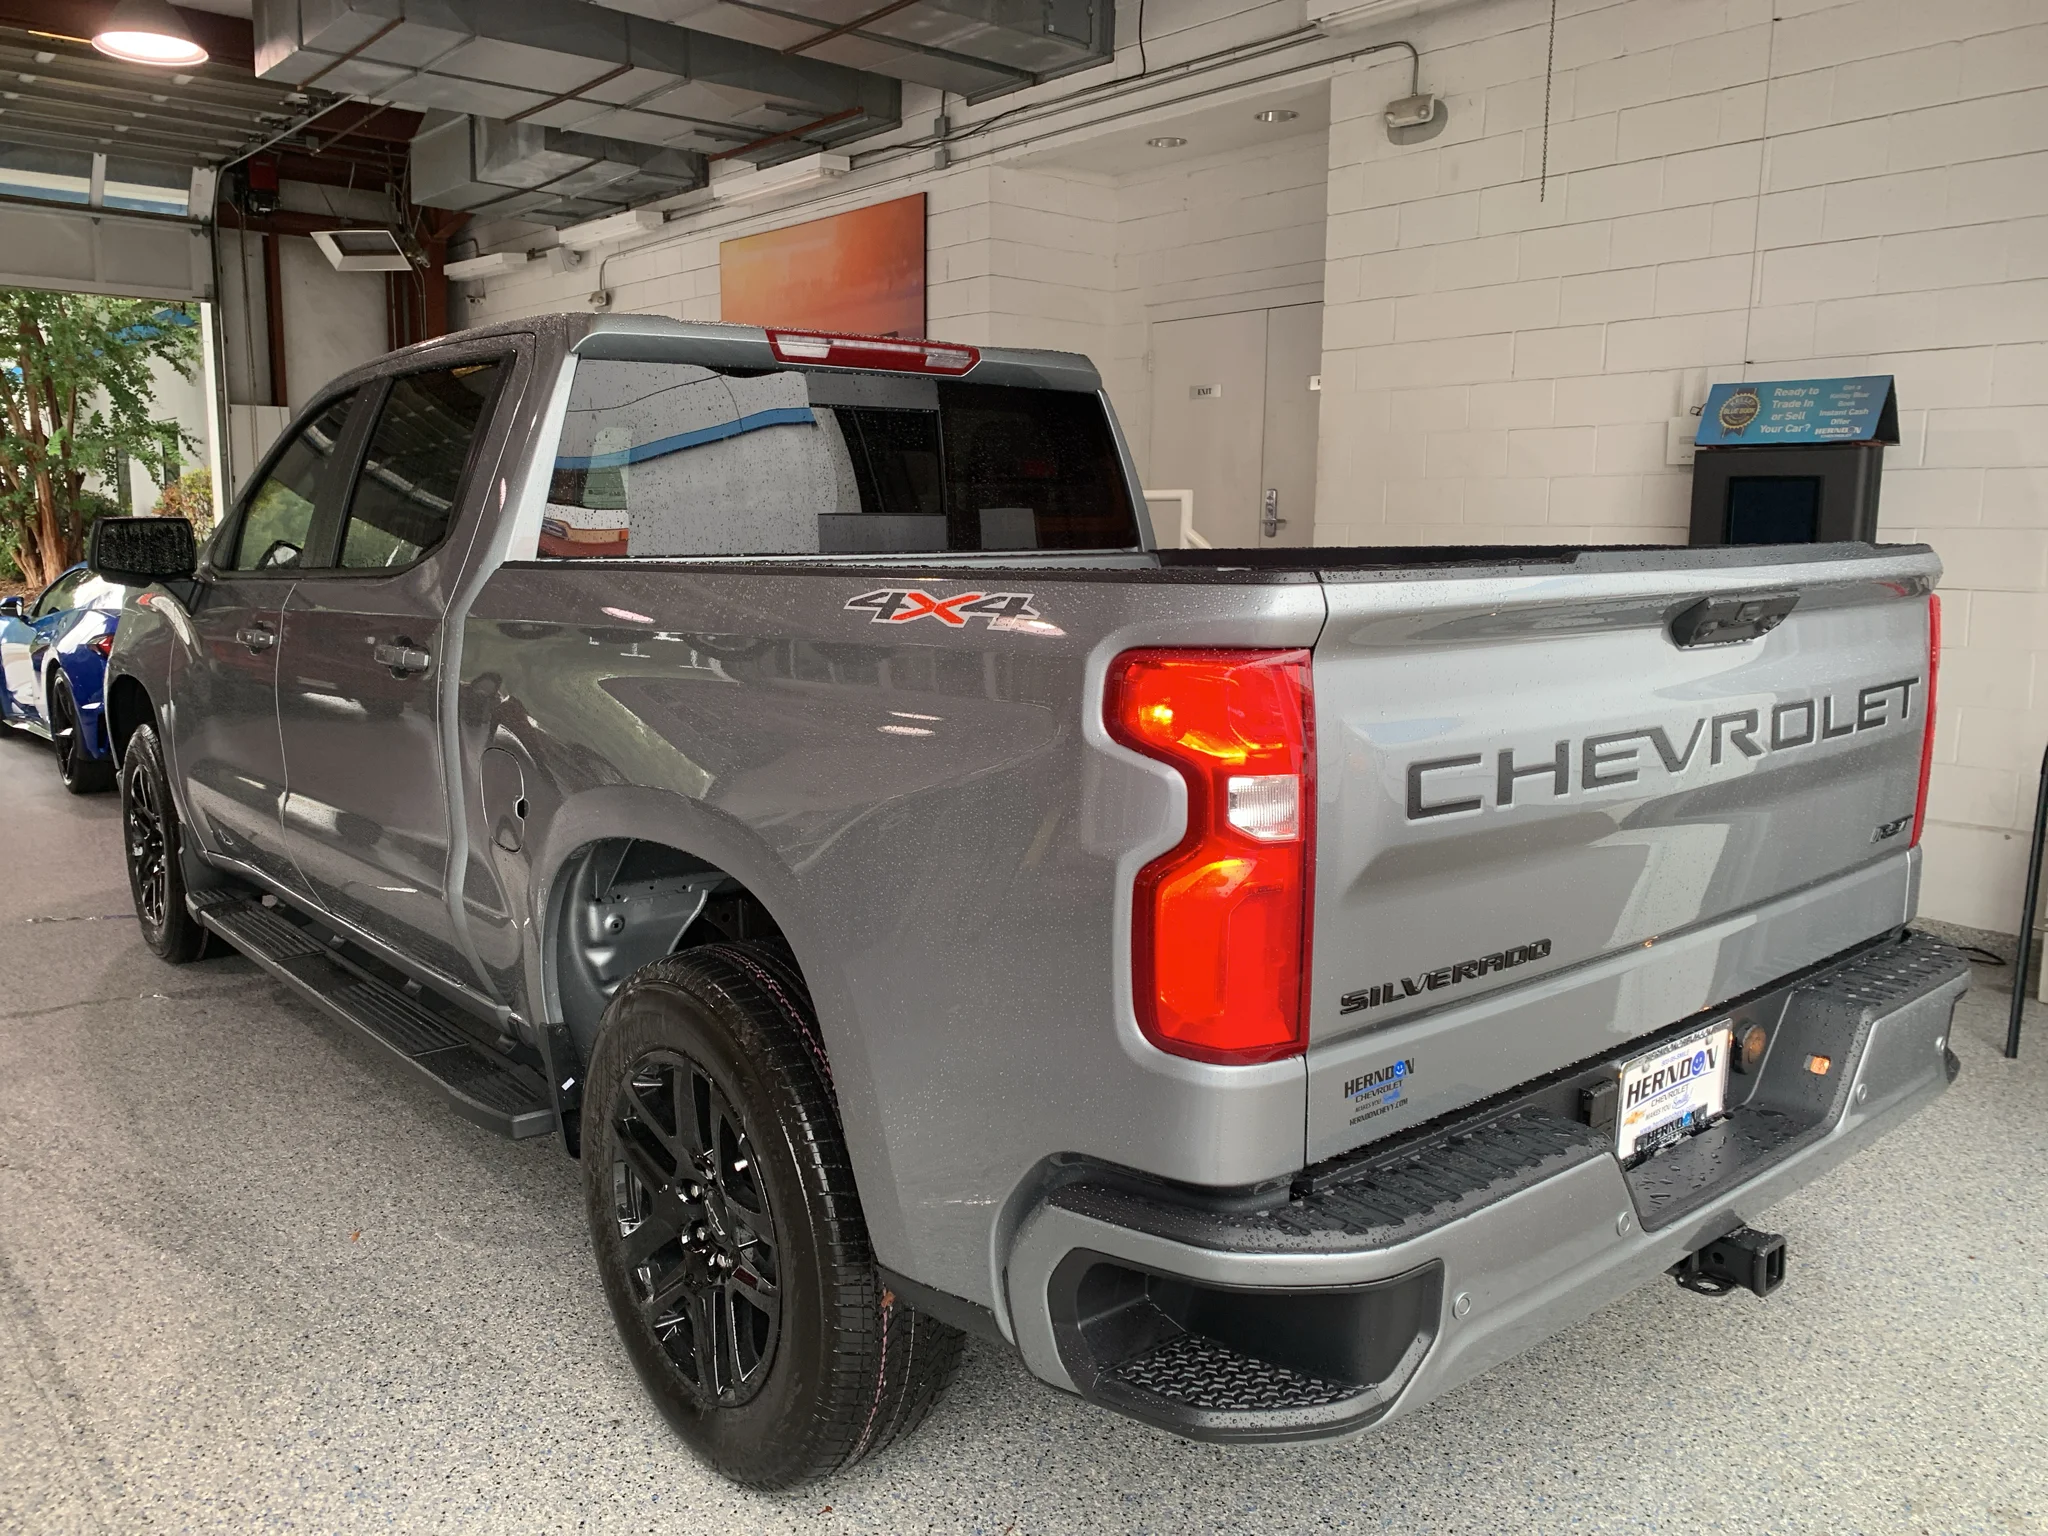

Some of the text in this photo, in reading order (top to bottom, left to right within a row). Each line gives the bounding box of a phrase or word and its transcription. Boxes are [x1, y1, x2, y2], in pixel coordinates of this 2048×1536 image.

[1772, 399, 1814, 409] Trade In
[1774, 387, 1820, 397] Ready to
[1760, 423, 1811, 433] Your Car?
[1771, 411, 1807, 421] or Sell
[1406, 676, 1921, 821] CHEVROLET
[1339, 938, 1553, 1016] SILVERADO
[1344, 1058, 1414, 1098] HERNDON
[1626, 1045, 1718, 1109] HERNDON
[1355, 1079, 1403, 1104] CHEVROLET
[1650, 1082, 1690, 1108] CHEVROLET
[1349, 1097, 1409, 1126] HERNDONCHEVY.COM
[1661, 1103, 1672, 1113] YOU
